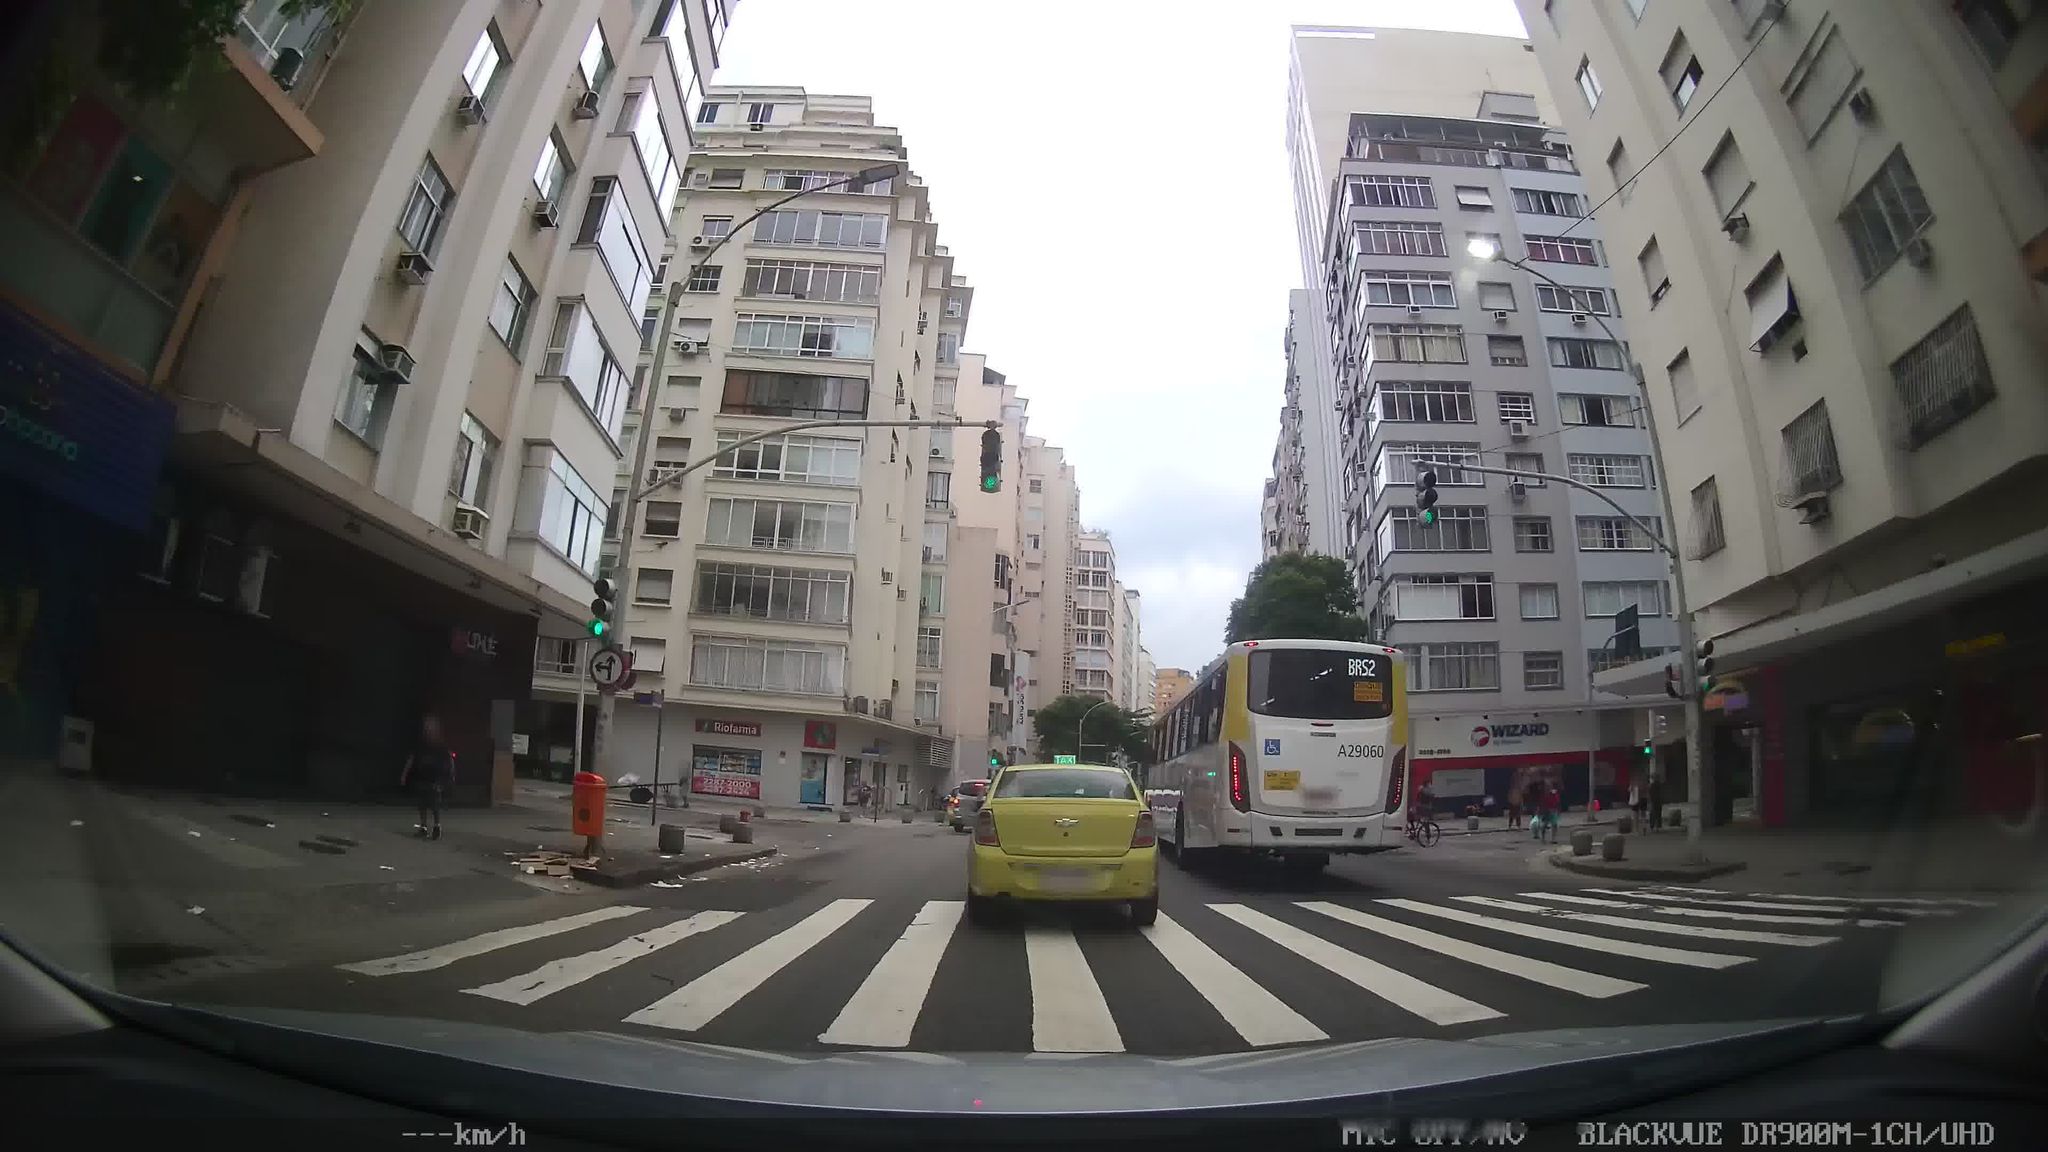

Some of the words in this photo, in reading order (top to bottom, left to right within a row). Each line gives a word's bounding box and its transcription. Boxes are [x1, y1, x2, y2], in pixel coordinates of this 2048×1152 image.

[1348, 658, 1376, 677] BRS2
[714, 722, 758, 735] Riofarma
[1490, 722, 1550, 738] WIZARD
[1337, 743, 1384, 758] A29060
